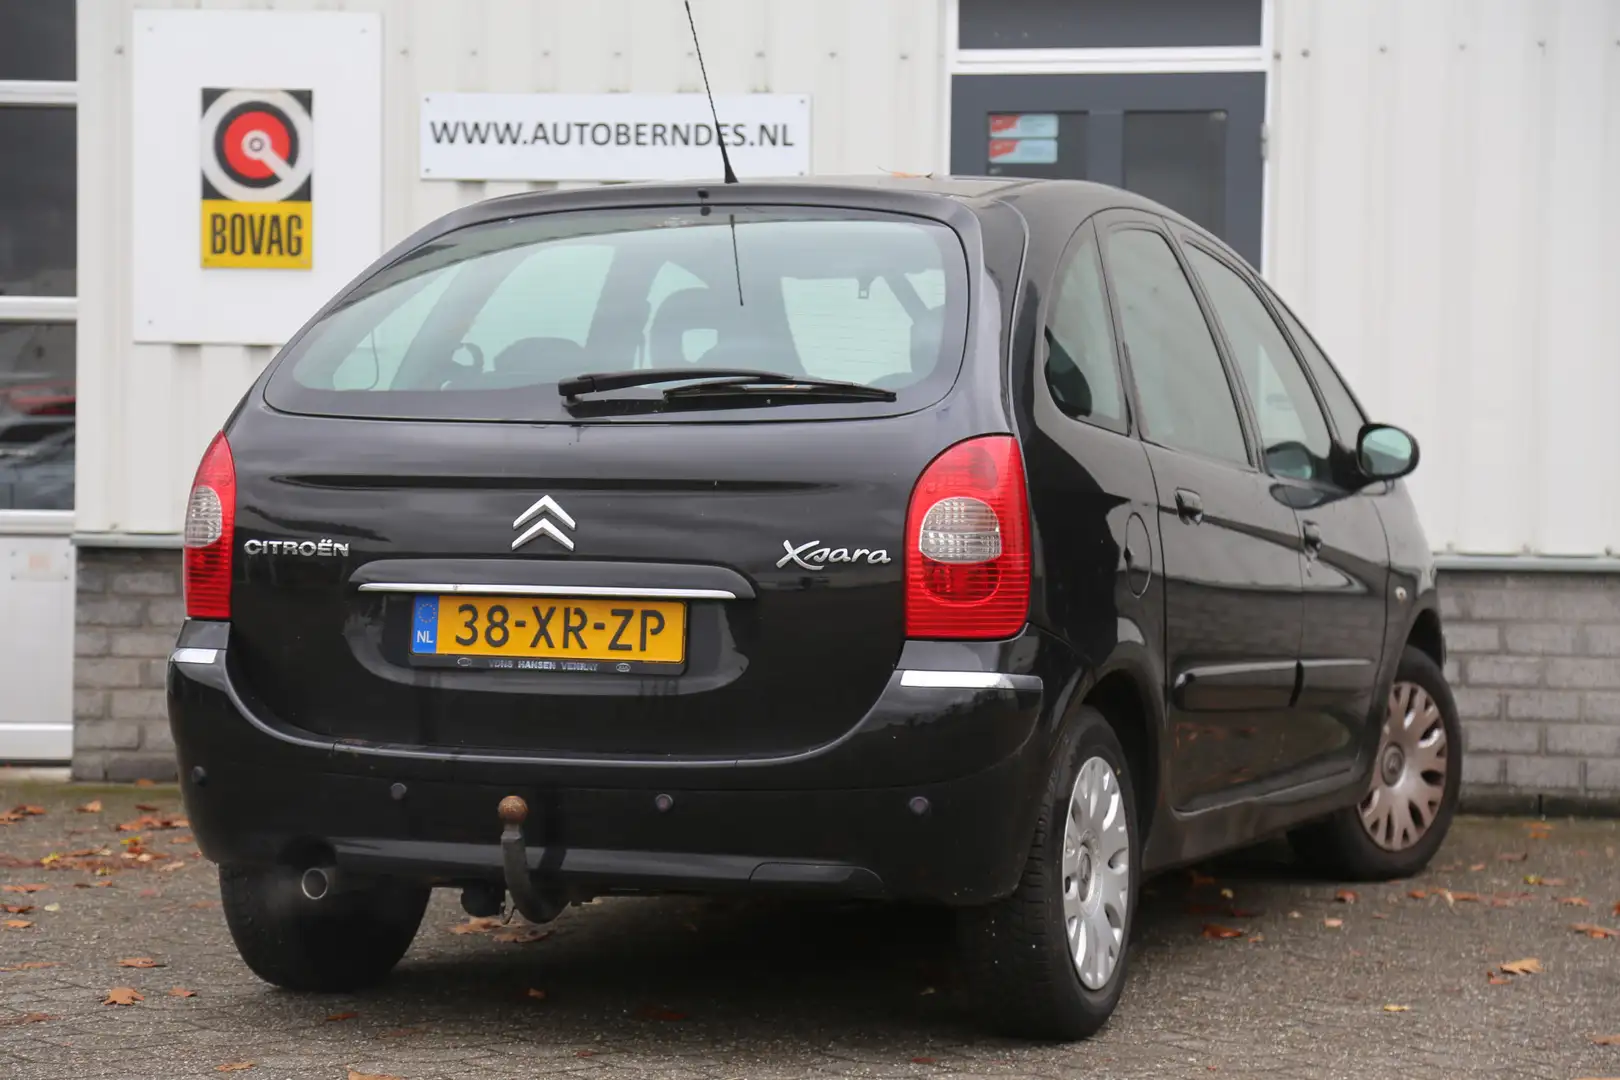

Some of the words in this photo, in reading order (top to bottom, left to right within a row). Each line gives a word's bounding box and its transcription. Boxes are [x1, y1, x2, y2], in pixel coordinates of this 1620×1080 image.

[430, 121, 794, 147] WWW.AUTOBERNDES.NL
[211, 213, 302, 256] BOVAG
[244, 539, 350, 557] CITROËN
[776, 540, 891, 570] Xsara
[416, 630, 433, 643] NL
[455, 604, 665, 652] 38-XR-ZP
